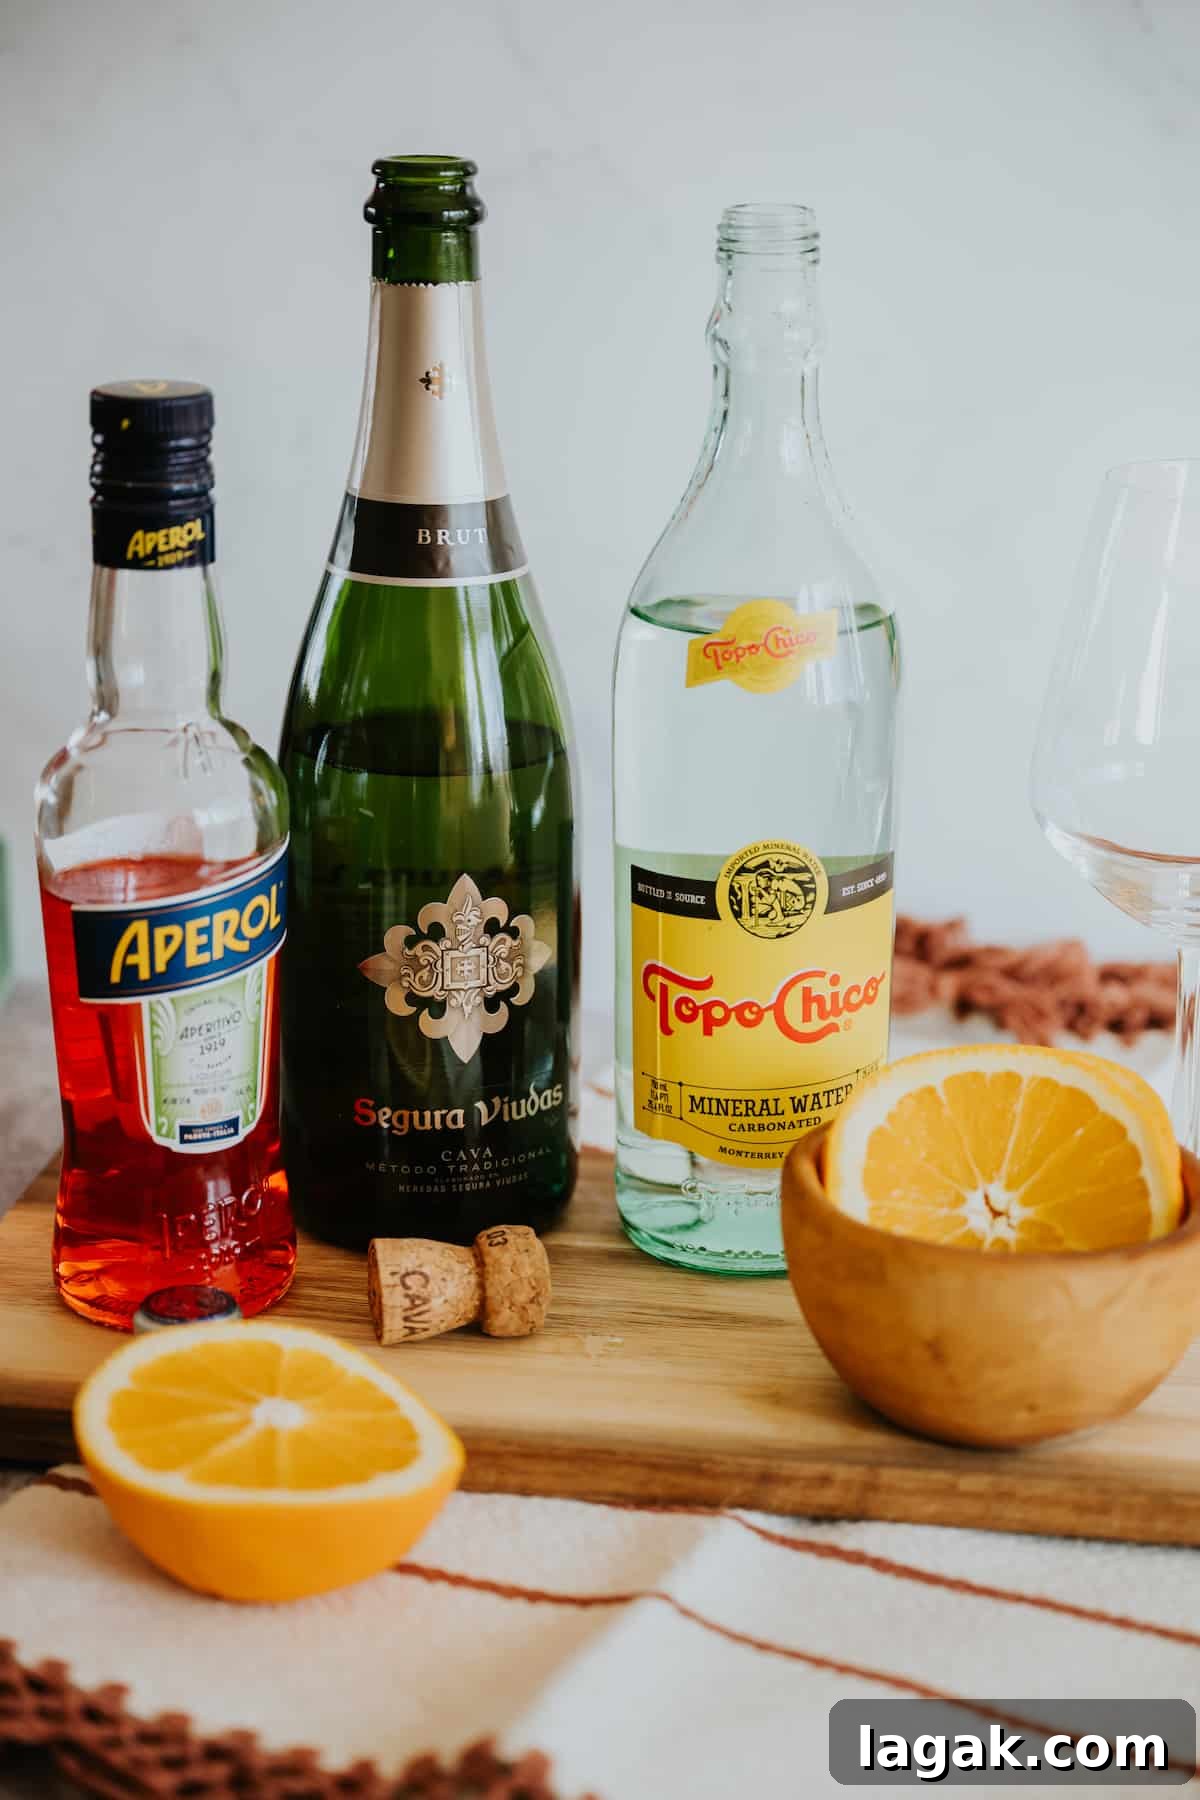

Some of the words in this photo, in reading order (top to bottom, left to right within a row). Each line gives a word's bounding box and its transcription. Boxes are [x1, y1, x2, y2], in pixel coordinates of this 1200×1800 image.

[126, 518, 206, 561] APEROL
[417, 527, 488, 546] BRUT
[702, 633, 761, 672] Topo
[761, 624, 818, 660] Chico
[674, 892, 706, 905] SOURCE
[109, 884, 282, 985] APEROL
[642, 961, 765, 1037] Topo
[773, 968, 886, 1044] Chico
[179, 1010, 243, 1041] APERITIVO
[199, 1038, 226, 1056] 1919
[353, 1097, 465, 1136] Segura
[473, 1081, 564, 1127] Viudas
[688, 1094, 785, 1118] MINERAL
[728, 1116, 822, 1133] CARBONATED
[440, 1146, 494, 1162] CAVA
[447, 1148, 553, 1174] TRADICIONAL
[718, 1145, 785, 1160] MONTERREY
[400, 1270, 430, 1338] CAVA
